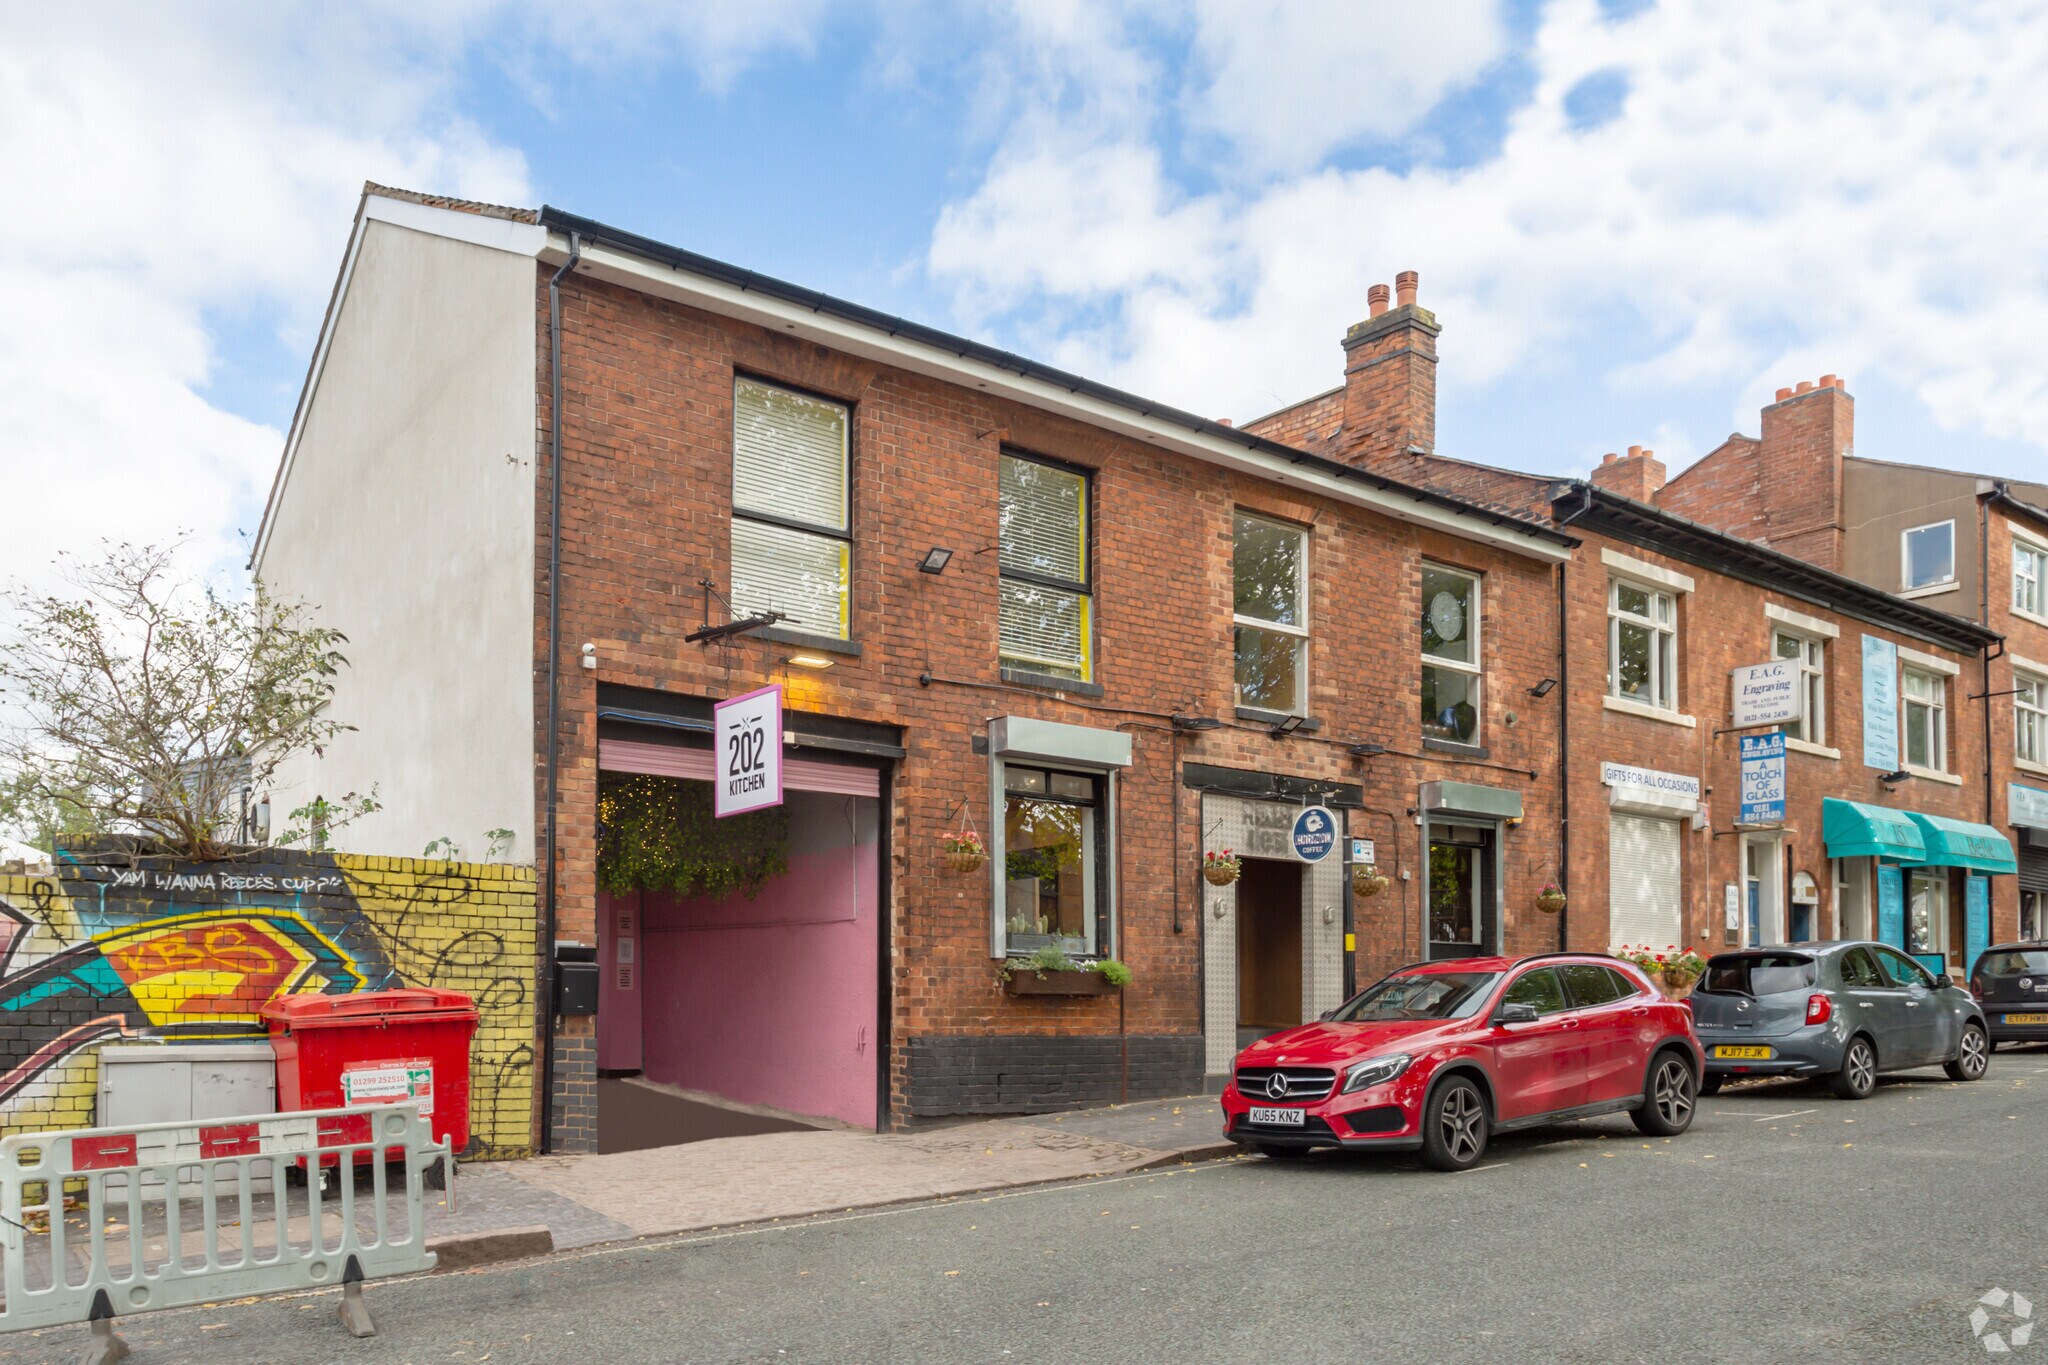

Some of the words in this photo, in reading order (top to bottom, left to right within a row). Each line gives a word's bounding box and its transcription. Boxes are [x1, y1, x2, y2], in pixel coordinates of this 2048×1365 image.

[1750, 665, 1785, 680] E.A.G.
[1743, 680, 1791, 696] Engraving
[1743, 735, 1783, 751] E.A.G.
[729, 727, 764, 777] 202
[1759, 761, 1767, 770] A
[1606, 768, 1627, 782] GIFTS
[1627, 772, 1643, 785] FOR
[1644, 775, 1657, 787] ALL
[1657, 777, 1698, 794] OCCASIONS
[1744, 769, 1782, 782] TOUCH
[729, 772, 765, 796] KITCHEN
[1756, 780, 1771, 790] OF
[1746, 788, 1779, 801] GLASS
[1302, 846, 1324, 854] COFFEE
[1966, 836, 1995, 858] Belle
[155, 873, 215, 890] WANNA
[1744, 1048, 1763, 1057] EJK
[353, 1077, 377, 1086] 01299
[378, 1075, 405, 1083] 252510
[1253, 1109, 1276, 1122] KU65
[1278, 1110, 1300, 1123] KNZ
